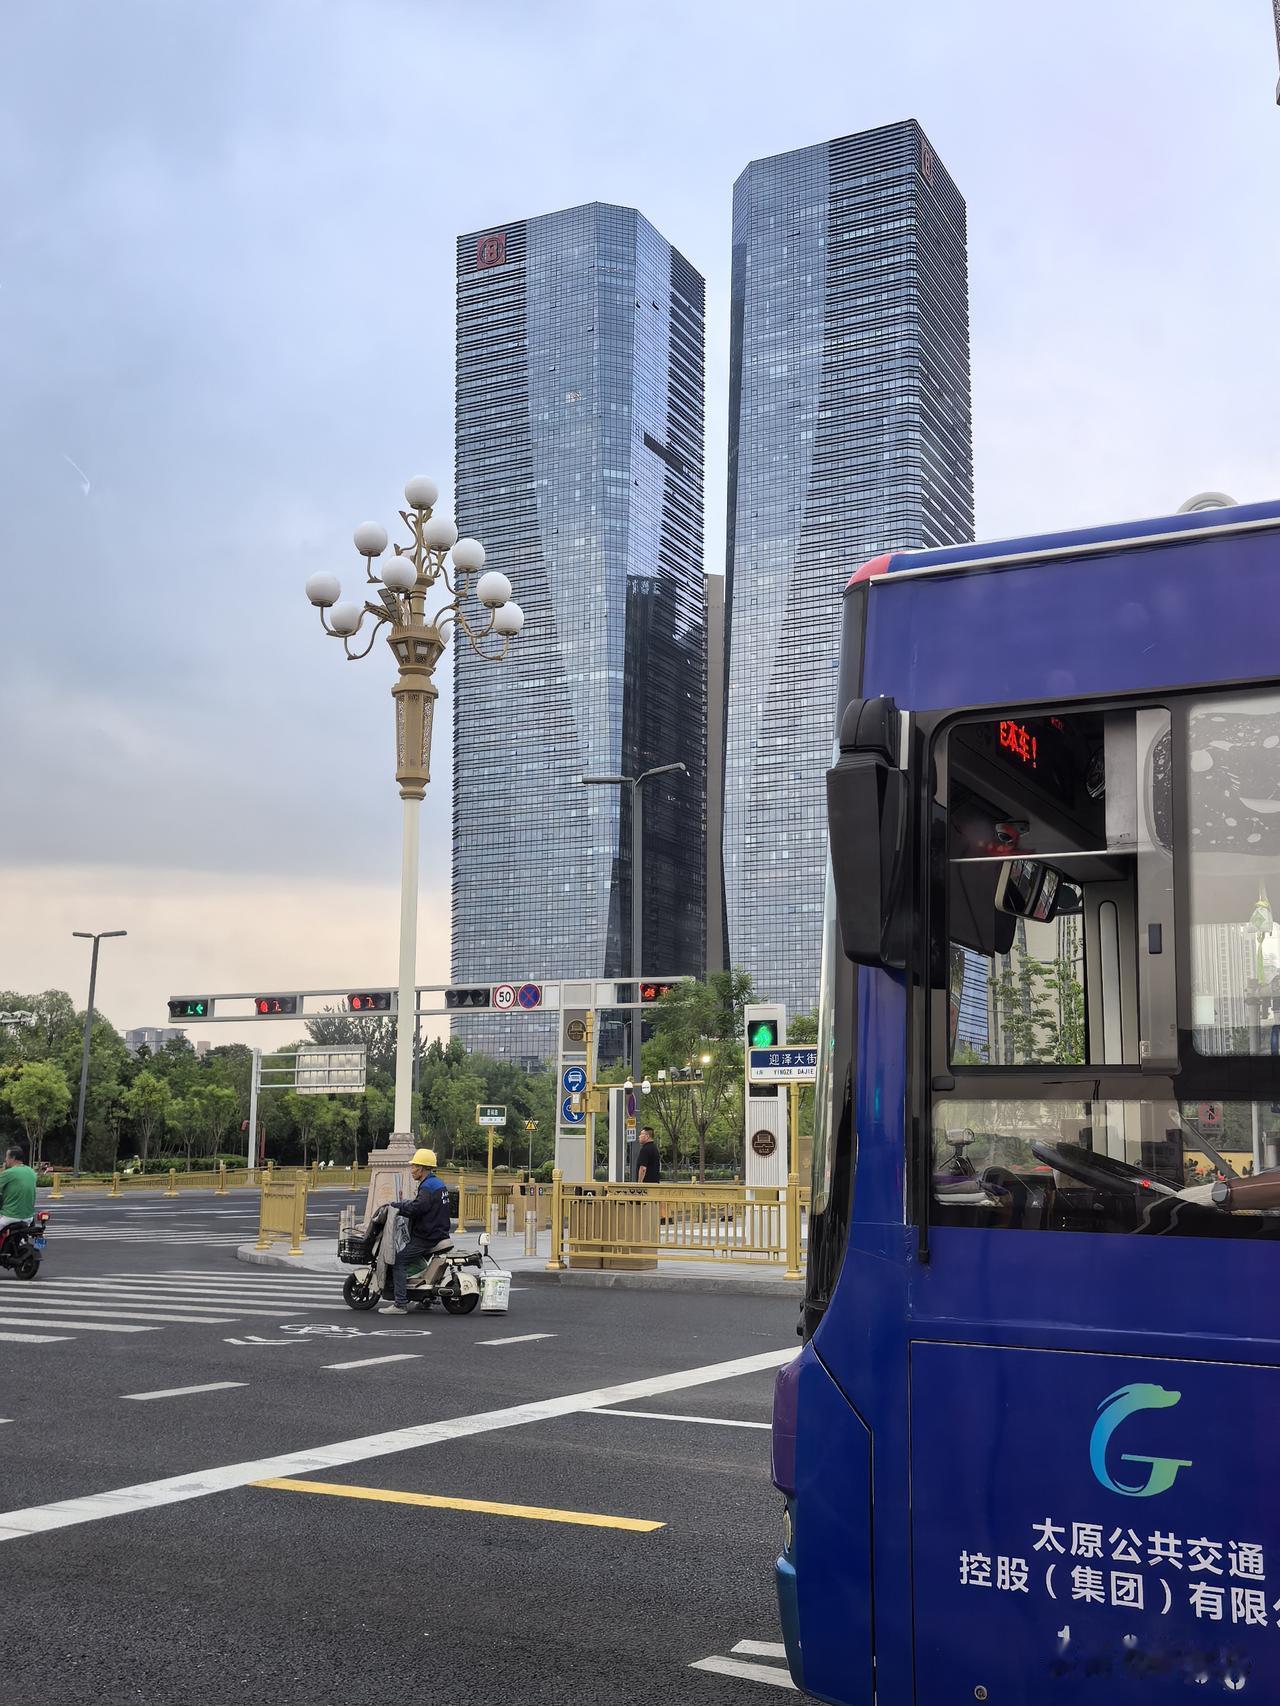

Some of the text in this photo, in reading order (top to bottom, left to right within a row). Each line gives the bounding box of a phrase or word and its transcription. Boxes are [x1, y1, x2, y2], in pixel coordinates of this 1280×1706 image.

[499, 991, 511, 1002] 50
[769, 1053, 816, 1066] 迎泽大街
[1032, 1517, 1265, 1580] 太原公共交通
[960, 1551, 1280, 1628] 控股（集团）有限
